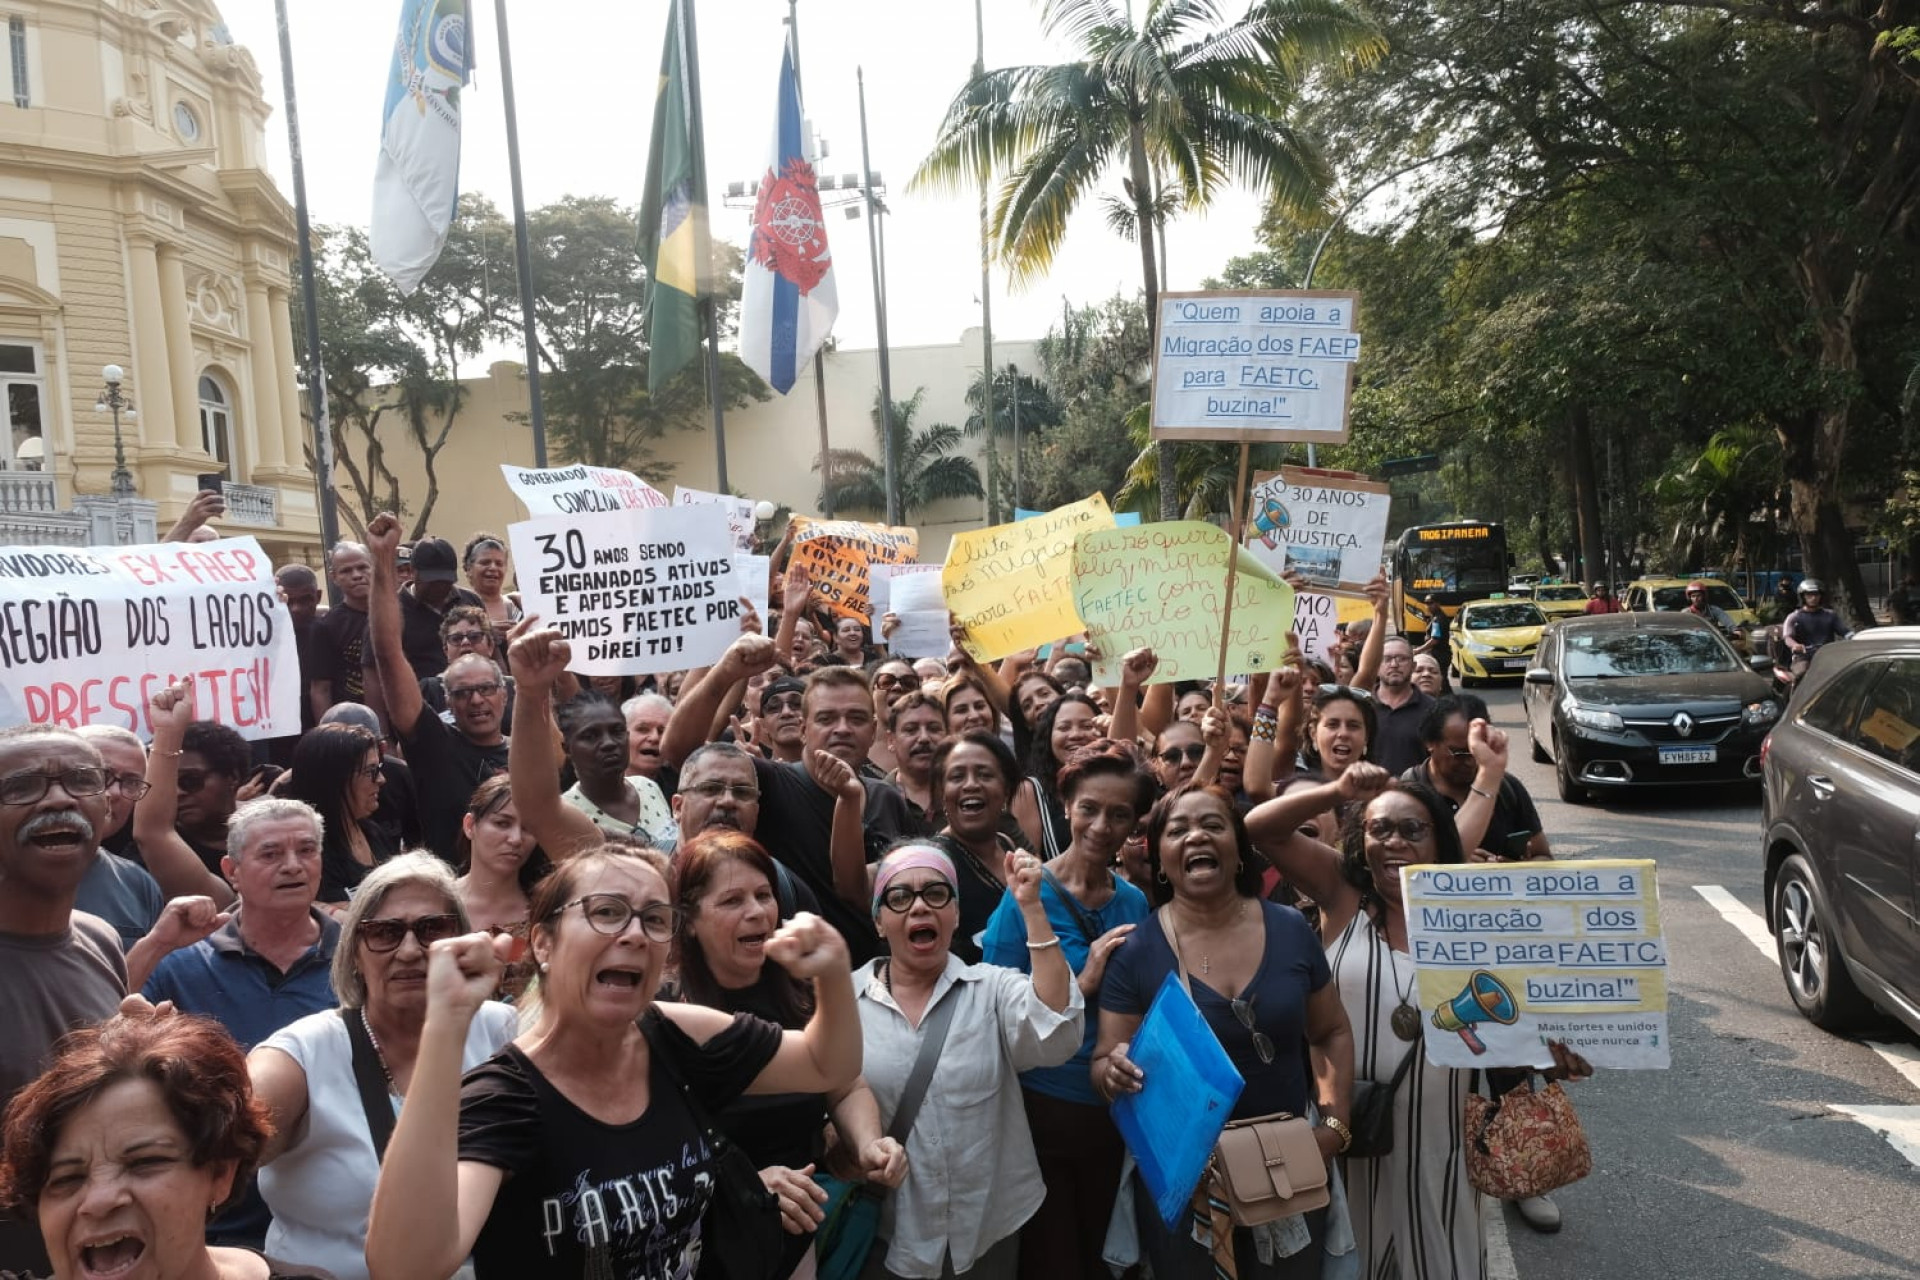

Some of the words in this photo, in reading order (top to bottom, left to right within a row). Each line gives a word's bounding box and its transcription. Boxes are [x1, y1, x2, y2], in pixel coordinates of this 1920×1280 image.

[1175, 302, 1240, 321] "Quem
[1260, 303, 1316, 323] apoia
[1328, 307, 1341, 322] a
[1165, 336, 1253, 357] Migração
[1257, 334, 1294, 353] dos
[1299, 337, 1358, 356] FAEP
[1183, 368, 1226, 388] para
[1207, 396, 1286, 415] buzina!"
[1292, 487, 1313, 502] 30
[1316, 488, 1366, 508] ANOS
[1307, 510, 1330, 526] DE
[534, 528, 587, 573] 30
[593, 547, 629, 566] ANOS
[639, 541, 686, 561] SENDO
[118, 549, 257, 585] EX-FAEP
[540, 567, 657, 595] ENGANADOS
[668, 558, 731, 581] ATIVOS
[556, 595, 569, 615] E
[578, 580, 715, 613] APOSENTADOS
[125, 596, 170, 648] DOS
[190, 592, 275, 650] LAGOS
[623, 606, 697, 634] FAETEC
[706, 599, 740, 623] POR
[1422, 870, 1512, 894] "Quem
[1525, 871, 1600, 896] apoia
[1618, 874, 1635, 892] a
[1422, 907, 1542, 933] Migração
[1586, 906, 1637, 928] dos
[1415, 940, 1488, 960] FAEP
[1496, 944, 1554, 965] para
[1558, 942, 1667, 967] FAETC,
[1526, 978, 1635, 999] buzina!"
[1537, 1023, 1566, 1032] Mais
[1568, 1021, 1604, 1032] fortes
[1607, 1024, 1615, 1032] e
[1617, 1021, 1659, 1032] unidos
[1576, 1038, 1599, 1048] que
[1602, 1037, 1640, 1046] nunca
[543, 1168, 677, 1257] PARIS
